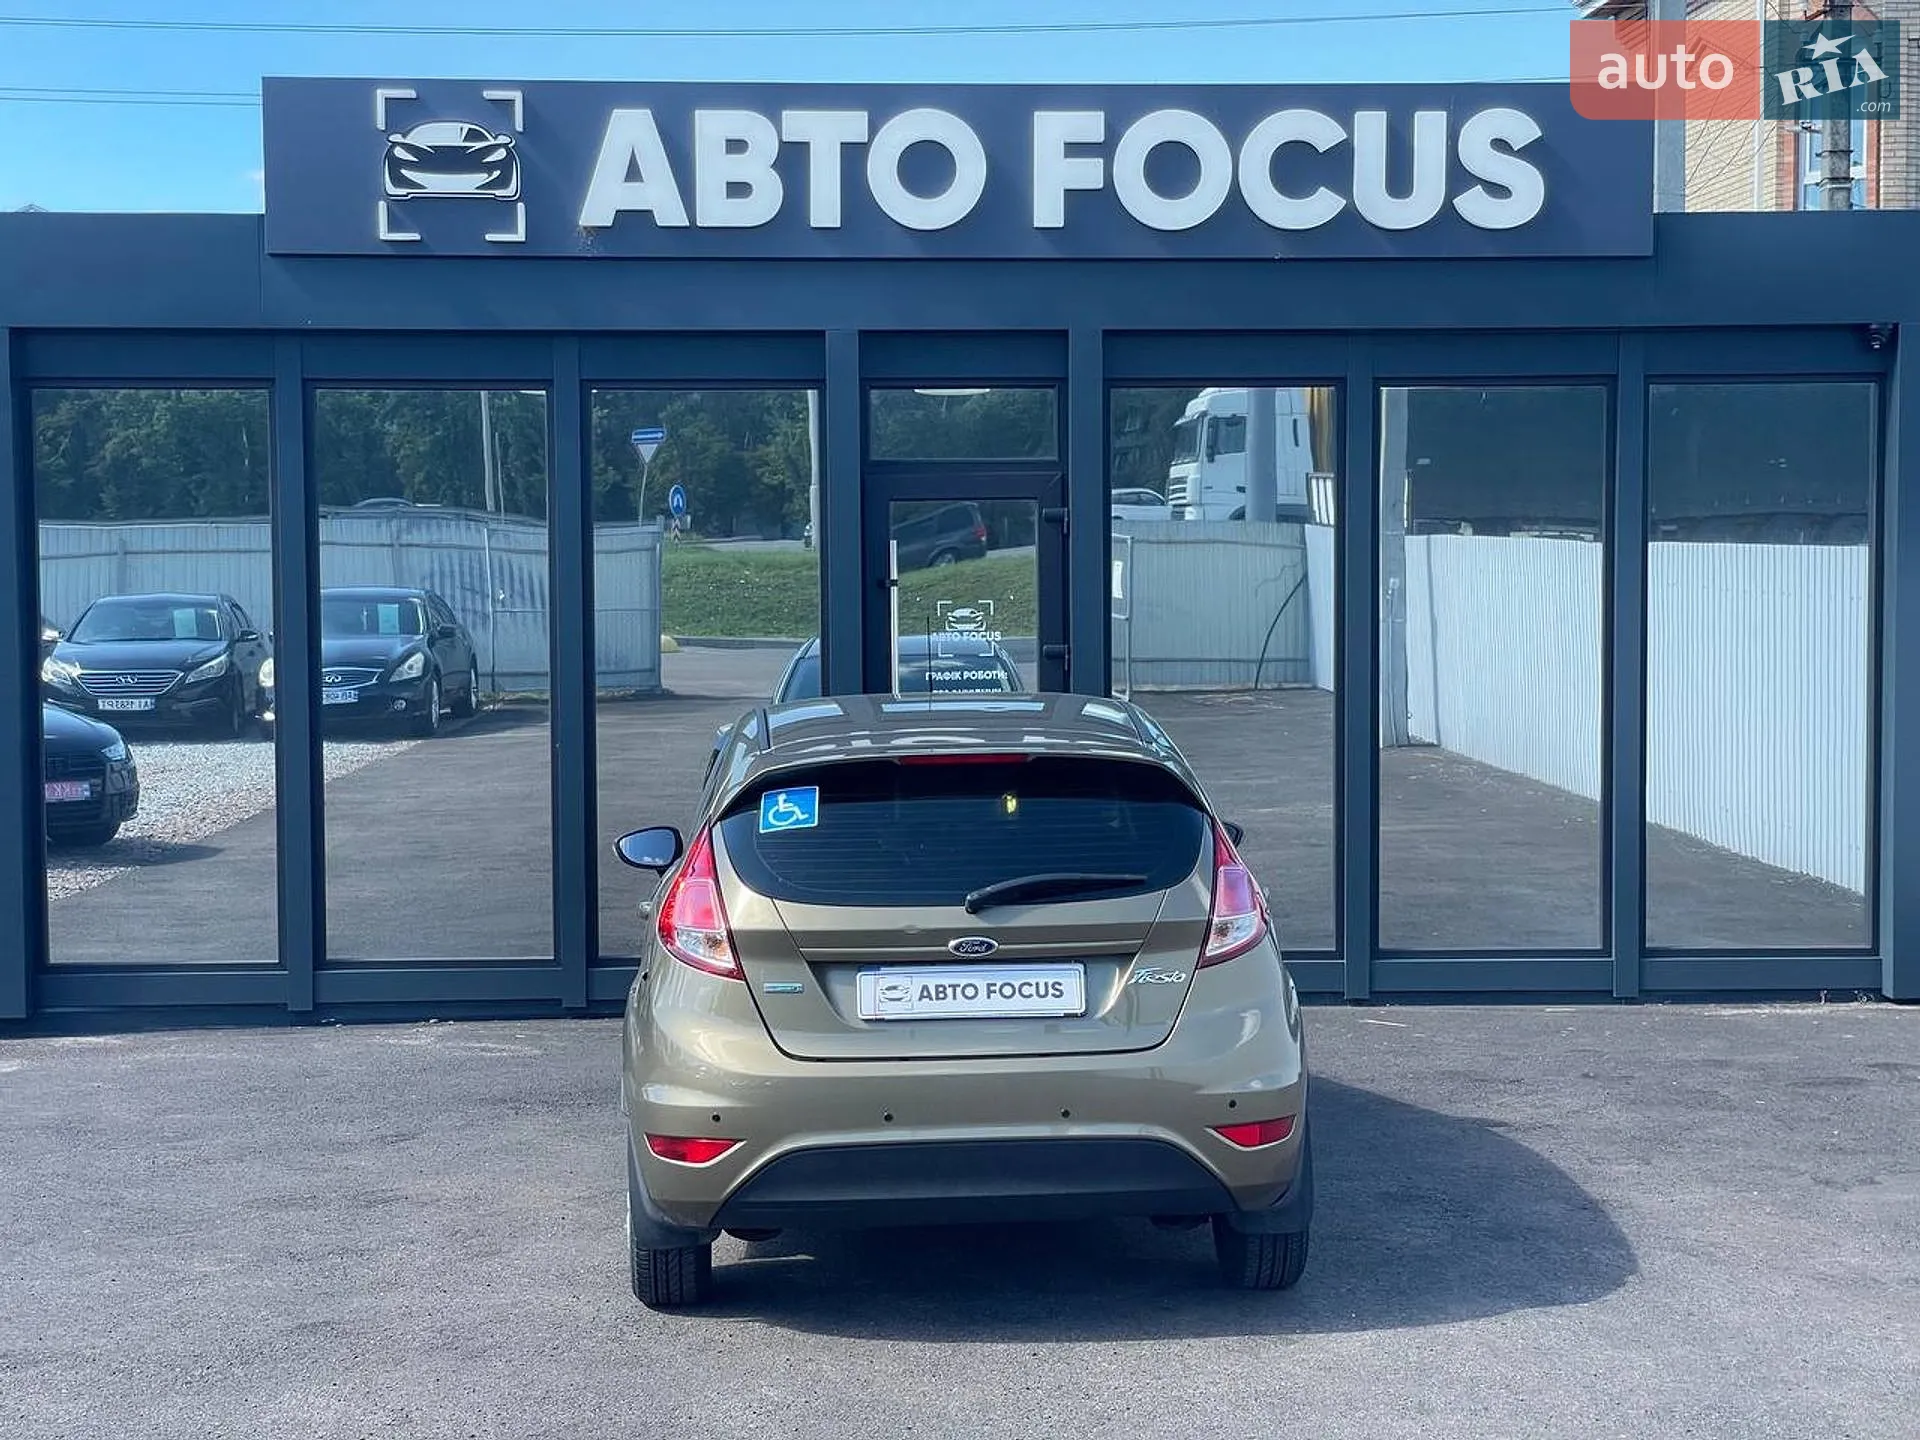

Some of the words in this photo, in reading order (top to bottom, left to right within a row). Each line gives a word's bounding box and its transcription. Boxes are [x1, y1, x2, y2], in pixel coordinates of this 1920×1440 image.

[579, 107, 987, 231] АВТО
[1033, 107, 1546, 231] FOCUS
[962, 631, 1002, 641] FOCUS
[1127, 967, 1187, 984] Fiesta
[918, 983, 979, 1002] АВТО
[986, 981, 1065, 1000] FOCUS
